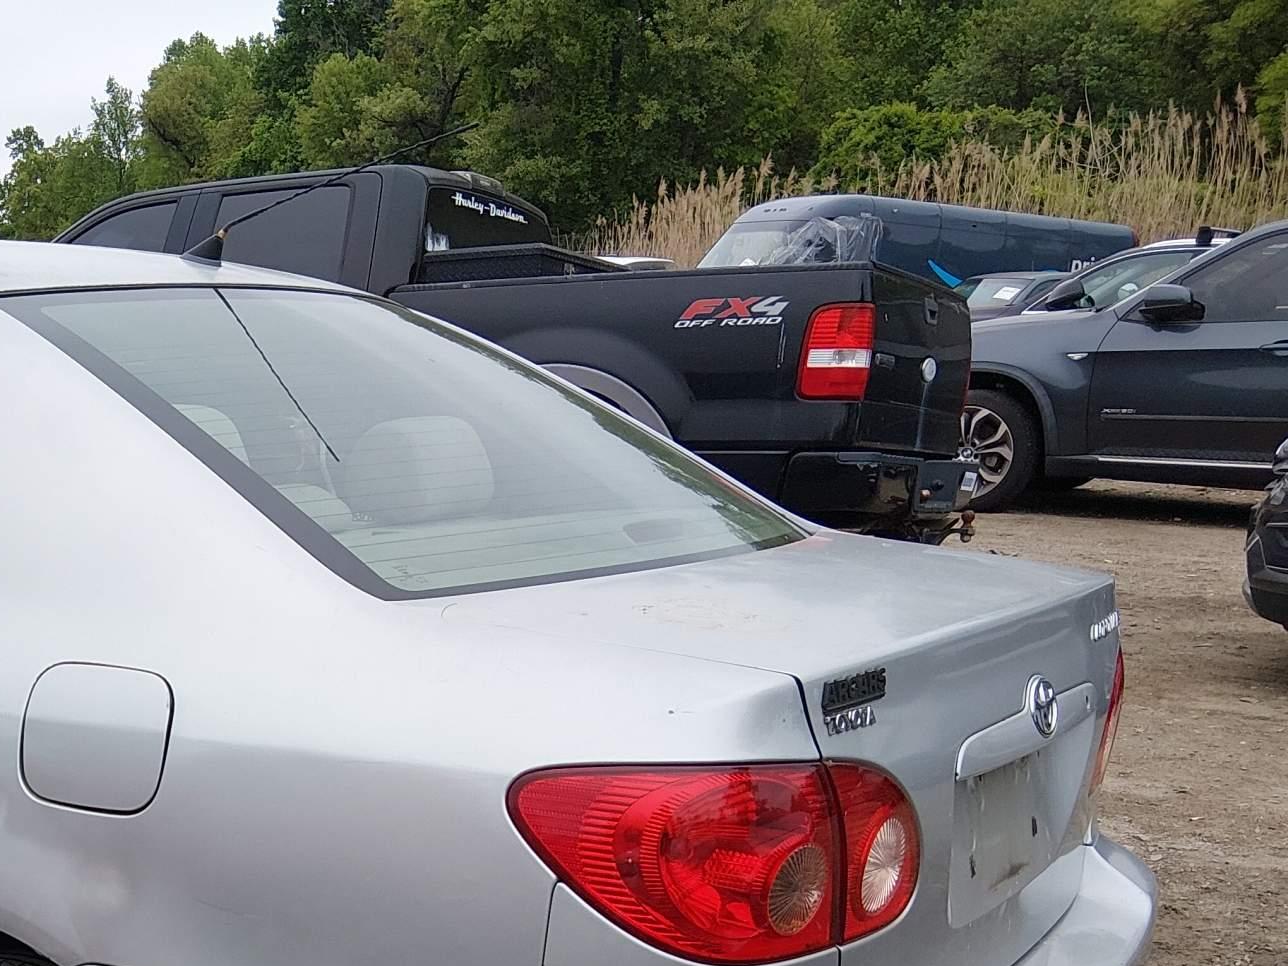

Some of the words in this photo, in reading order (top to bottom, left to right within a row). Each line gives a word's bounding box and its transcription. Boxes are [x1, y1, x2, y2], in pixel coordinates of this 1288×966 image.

[451, 192, 528, 224] Harley-Davidson
[679, 295, 791, 320] FX4
[674, 318, 717, 329] OFF
[719, 316, 783, 327] ROAD
[823, 705, 877, 737] TOYOTA
